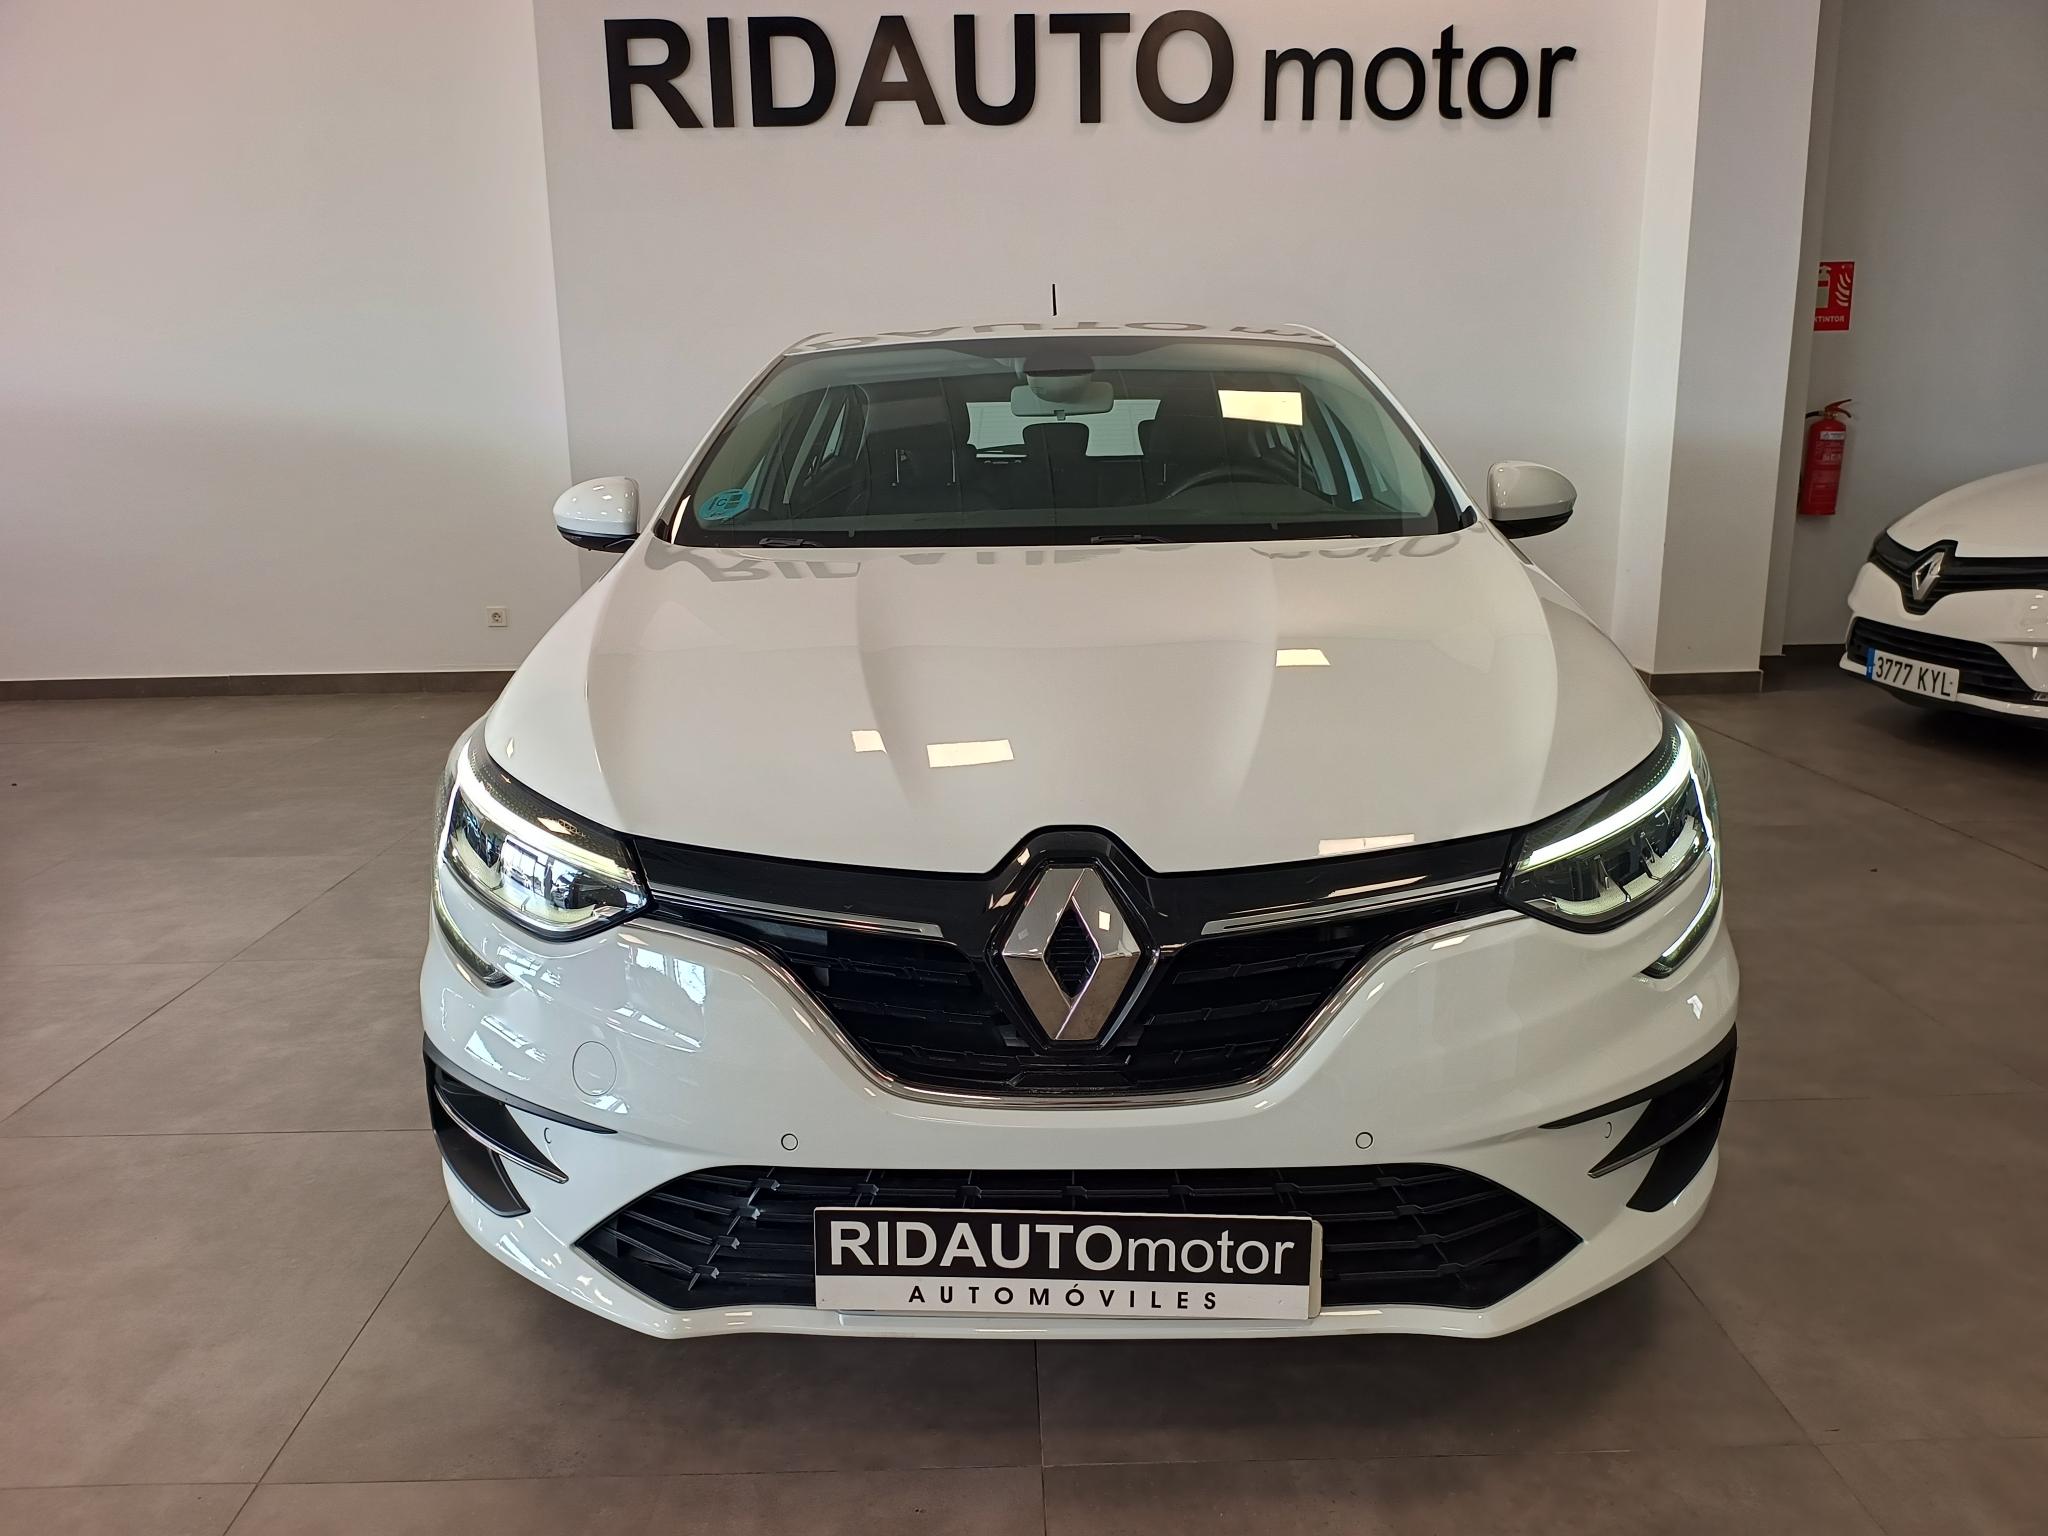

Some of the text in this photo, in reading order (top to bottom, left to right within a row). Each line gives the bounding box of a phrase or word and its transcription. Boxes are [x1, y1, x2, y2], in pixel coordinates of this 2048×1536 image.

[603, 9, 1578, 130] RIDAUTO motor
[1875, 656, 1951, 697] 3777 KYL
[908, 1283, 1217, 1311] AUTOMÓVILES
